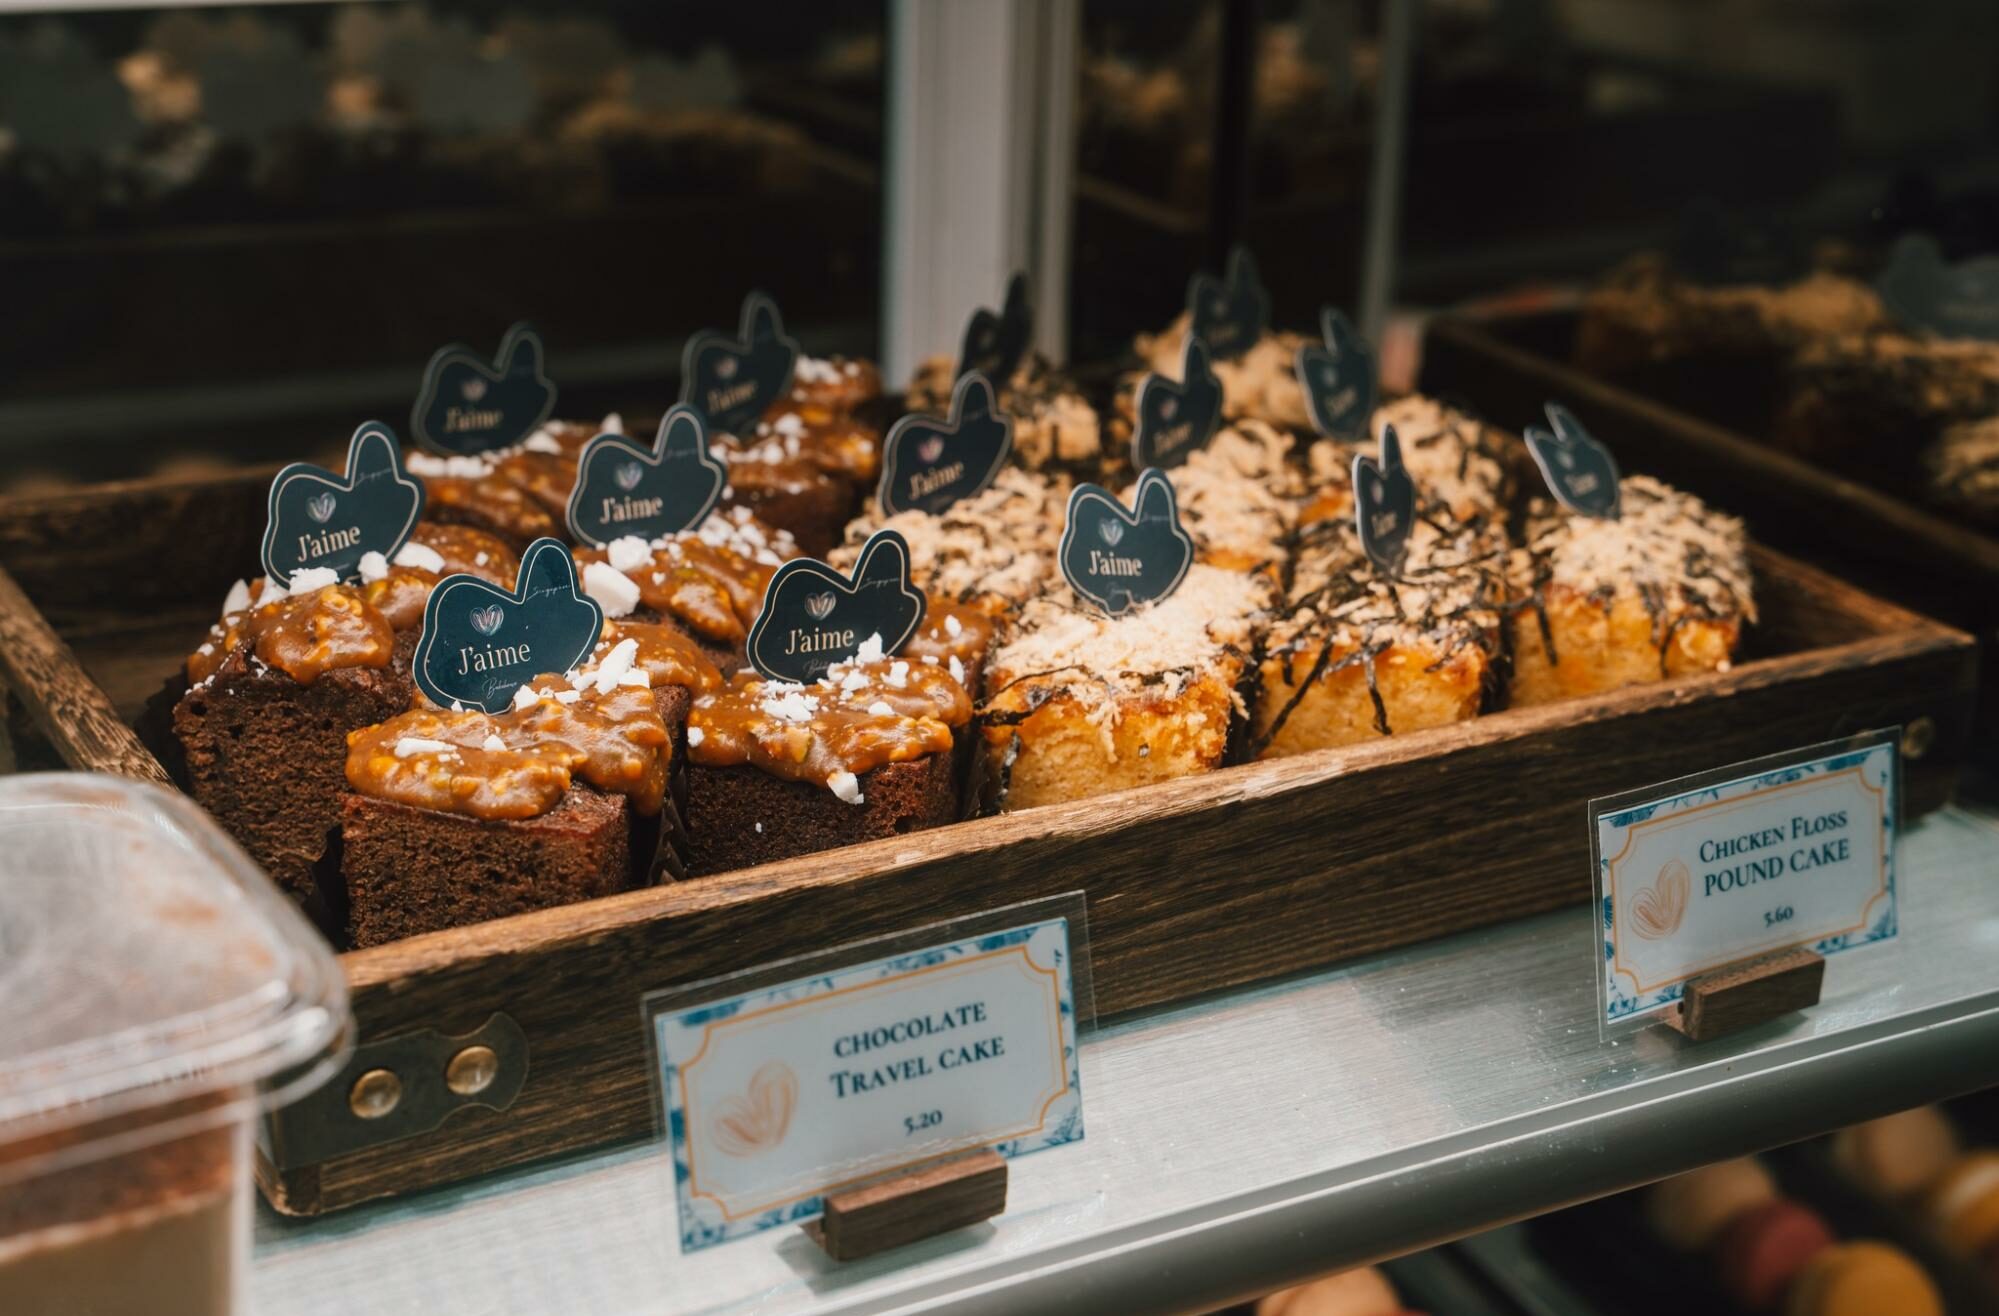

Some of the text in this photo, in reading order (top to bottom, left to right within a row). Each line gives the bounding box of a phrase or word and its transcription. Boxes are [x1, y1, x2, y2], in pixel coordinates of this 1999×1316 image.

[600, 496, 663, 524] J'aime
[297, 526, 361, 562] J'aime
[1088, 550, 1142, 576] J'aime
[785, 627, 854, 655] J'aime
[458, 643, 532, 675] J'aime
[1699, 810, 1848, 863] CHICKEN FLOSS
[1704, 838, 1849, 897] POUND CAKE
[1764, 905, 1794, 928] 5.60
[833, 1002, 987, 1058] CHOCOLATE
[830, 1036, 1005, 1099] TRAVEL CAKE
[904, 1109, 943, 1136] 5.20
